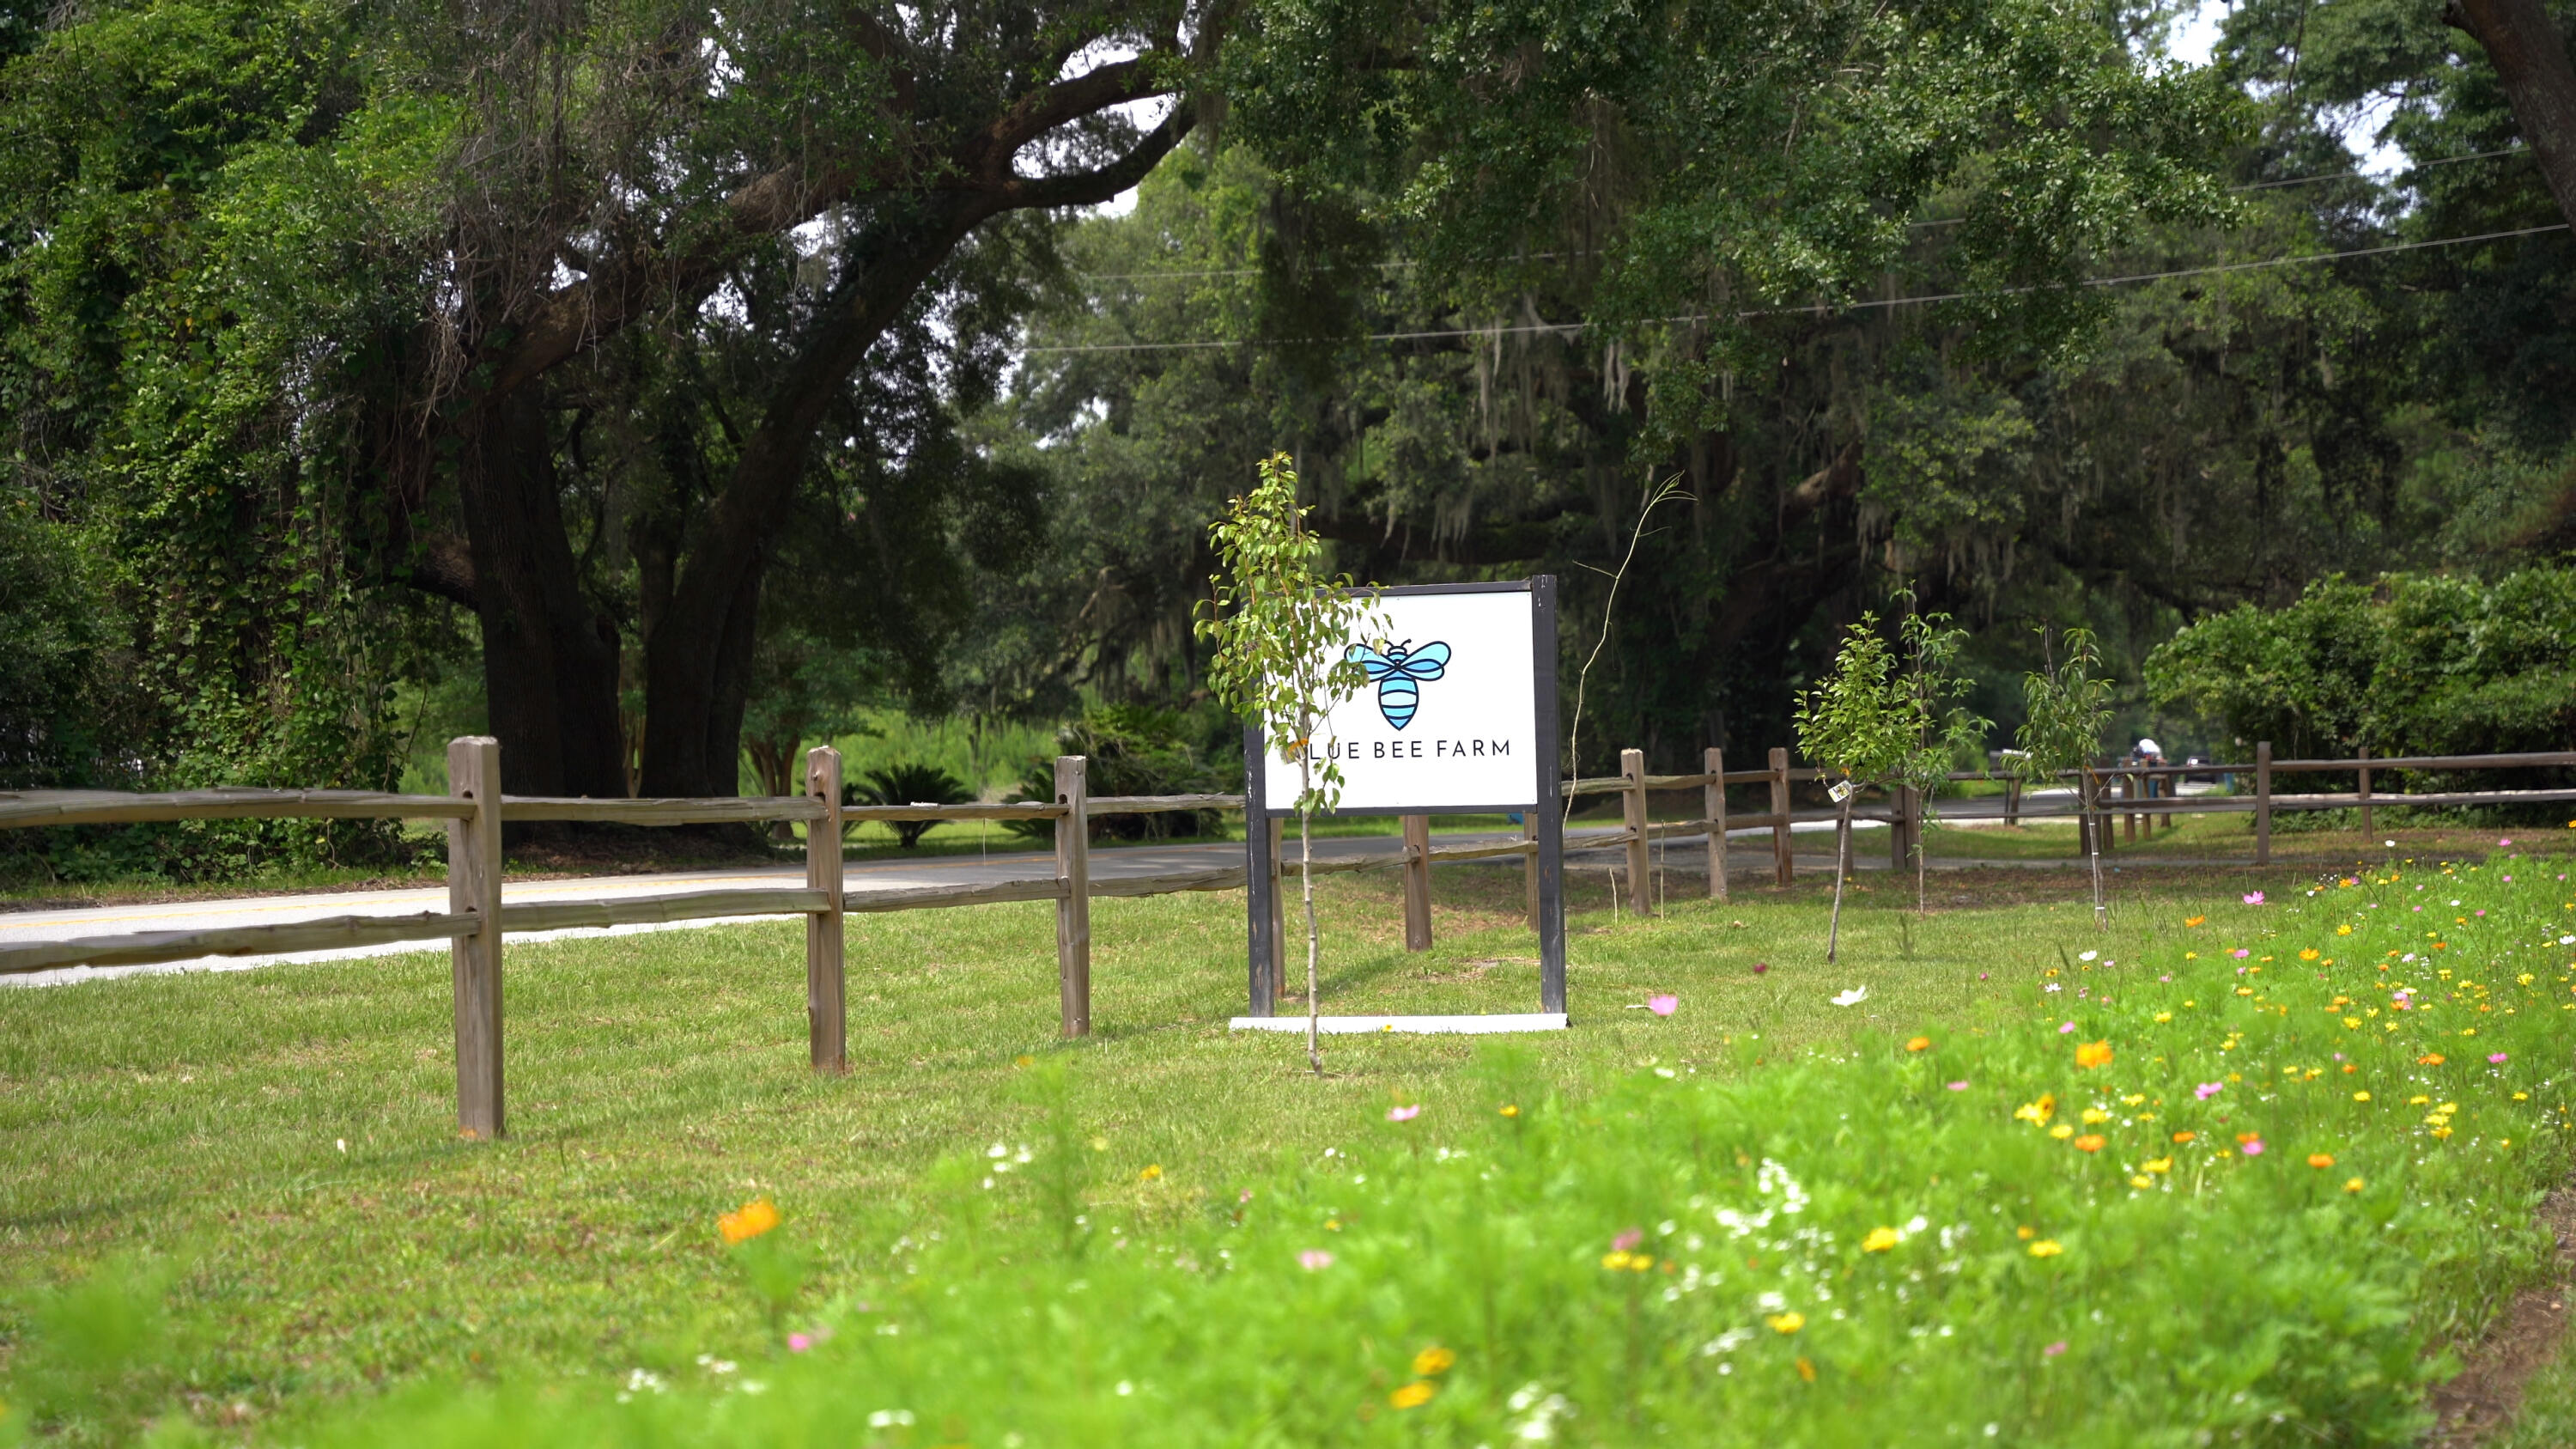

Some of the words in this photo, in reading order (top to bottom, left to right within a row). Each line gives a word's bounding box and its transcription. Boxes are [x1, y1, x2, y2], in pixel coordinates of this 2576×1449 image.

[1309, 742, 1361, 760] LUE
[1374, 741, 1423, 758] BEE
[1437, 740, 1510, 758] FARM
